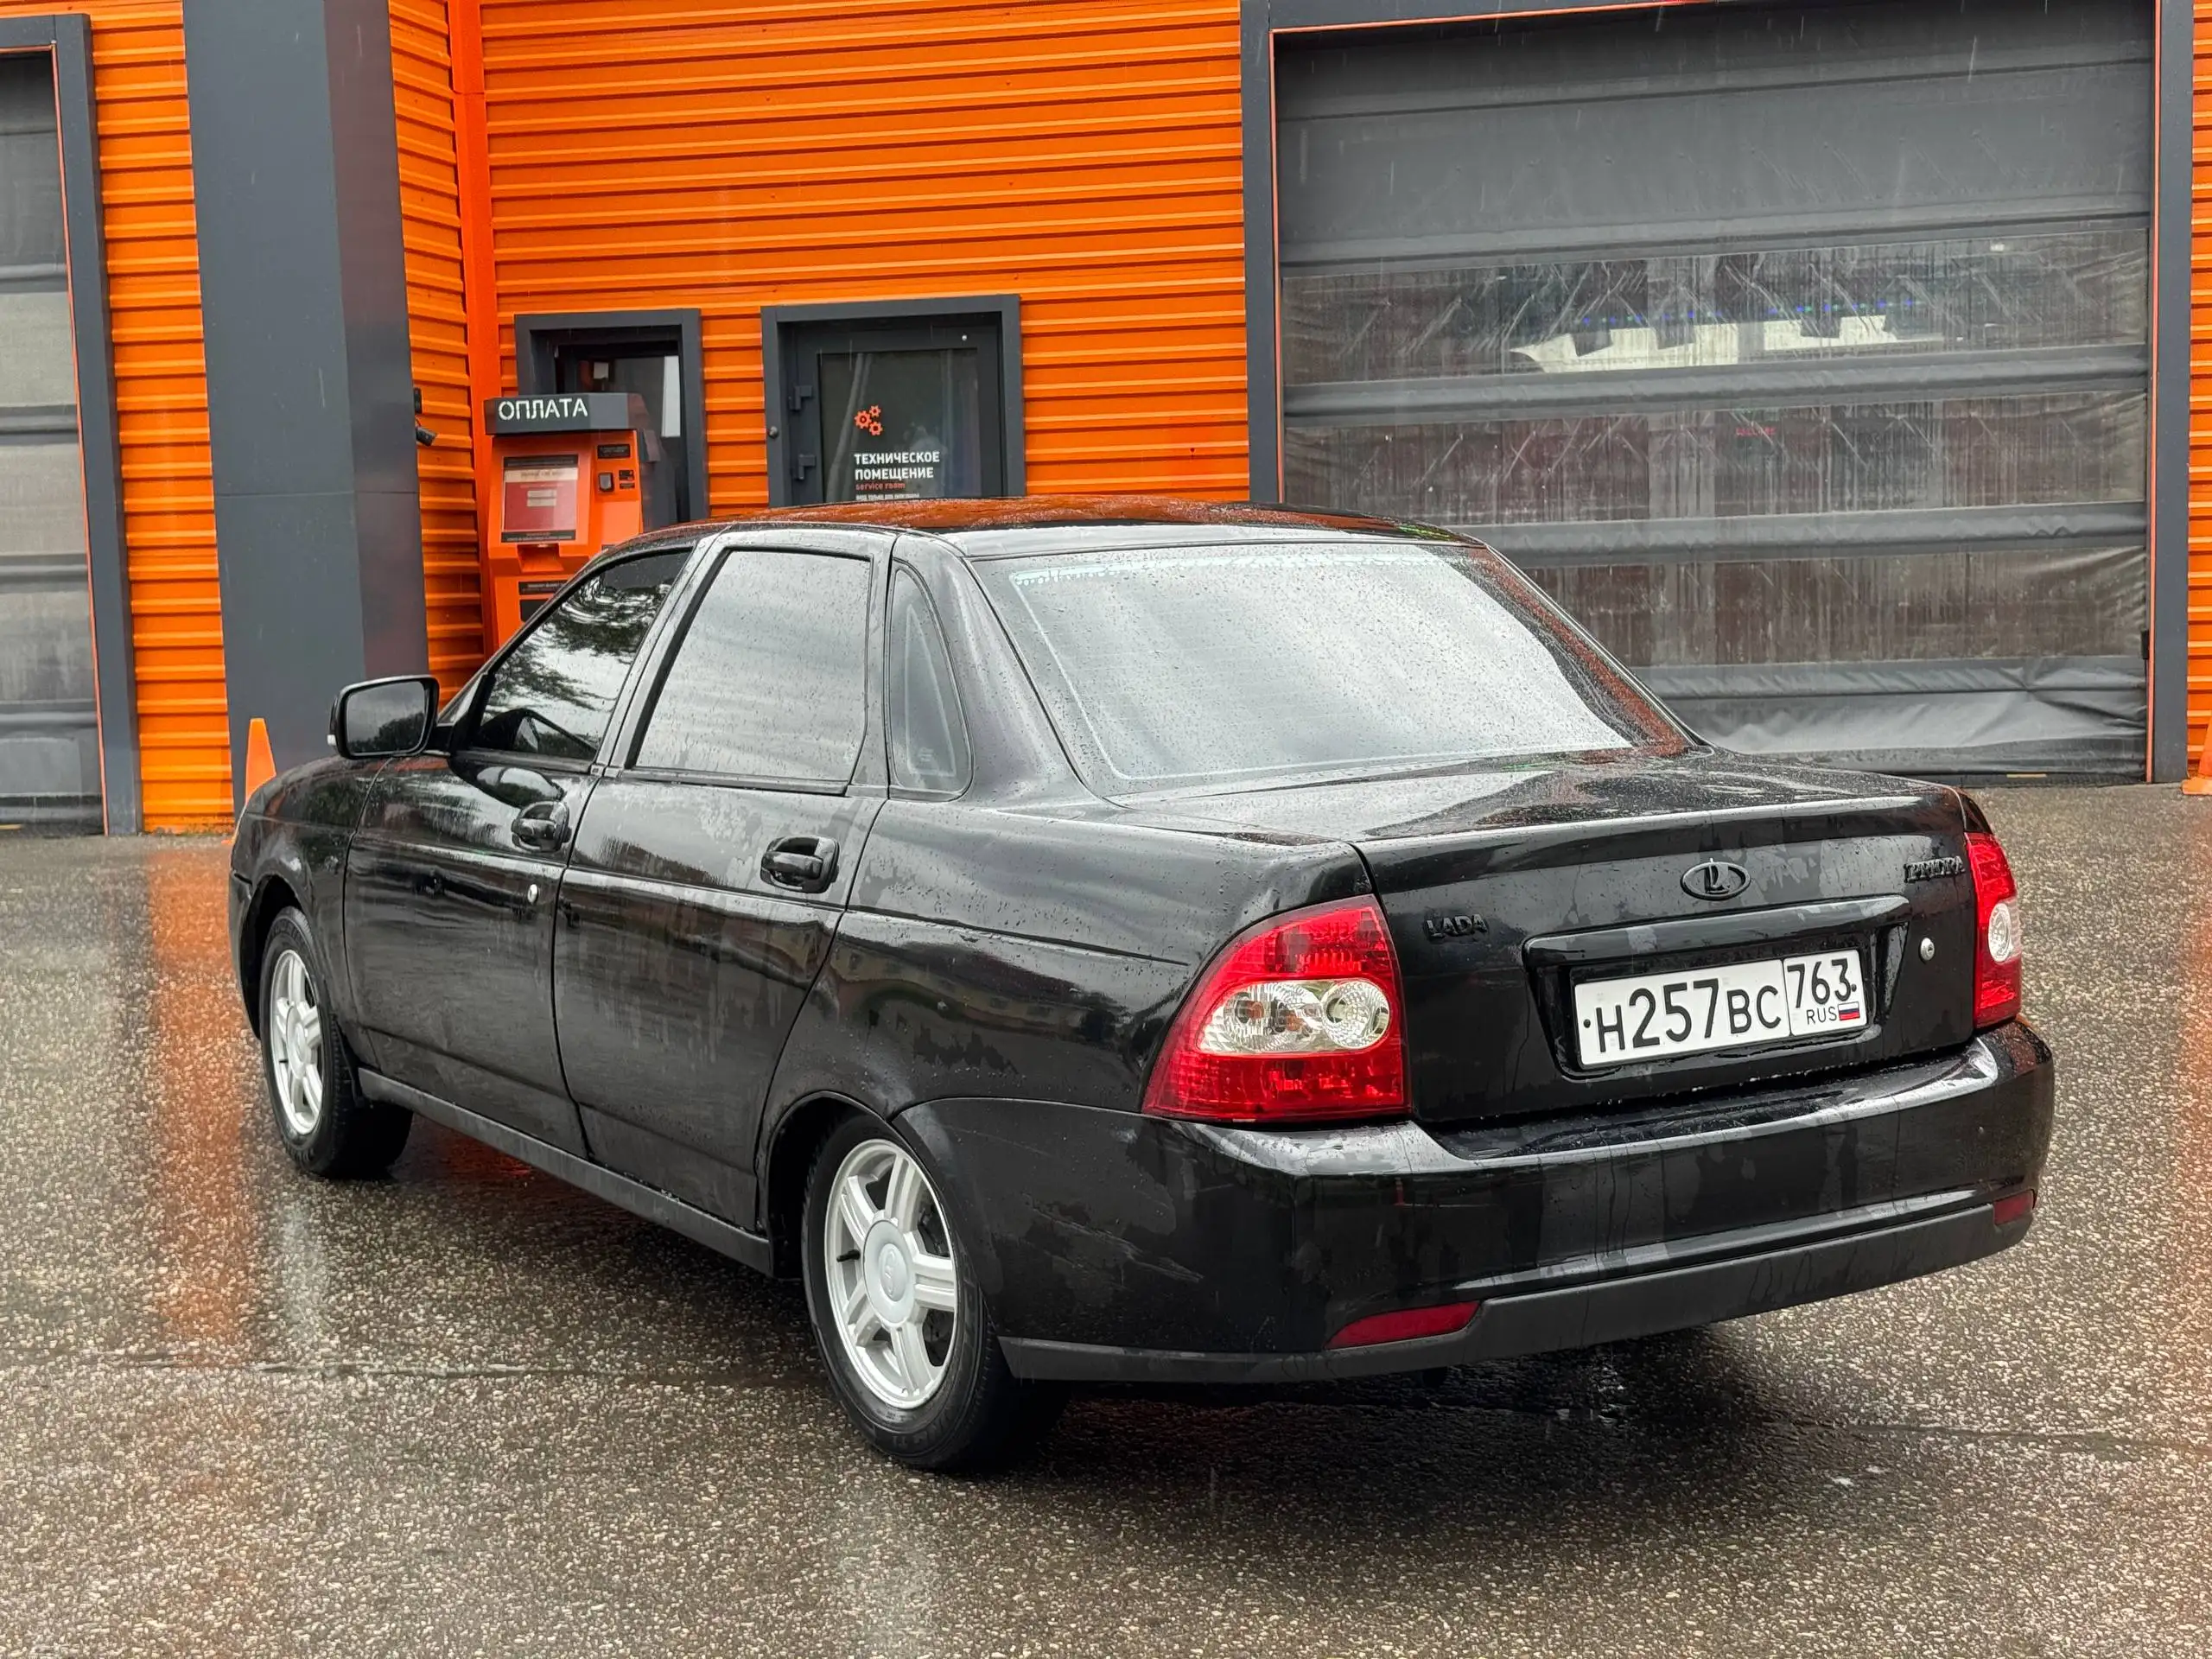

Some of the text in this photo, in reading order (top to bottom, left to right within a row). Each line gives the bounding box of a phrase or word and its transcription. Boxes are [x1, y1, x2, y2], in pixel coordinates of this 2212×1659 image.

[499, 397, 588, 421] ОПЛАТА
[854, 451, 940, 465] ТЕХНИЧЕСКОЕ
[855, 467, 934, 480] ПОМЕЩЕНИЕ
[1425, 913, 1487, 938] LADA
[1787, 958, 1852, 1008] 763
[1806, 1004, 1838, 1026] RUS
